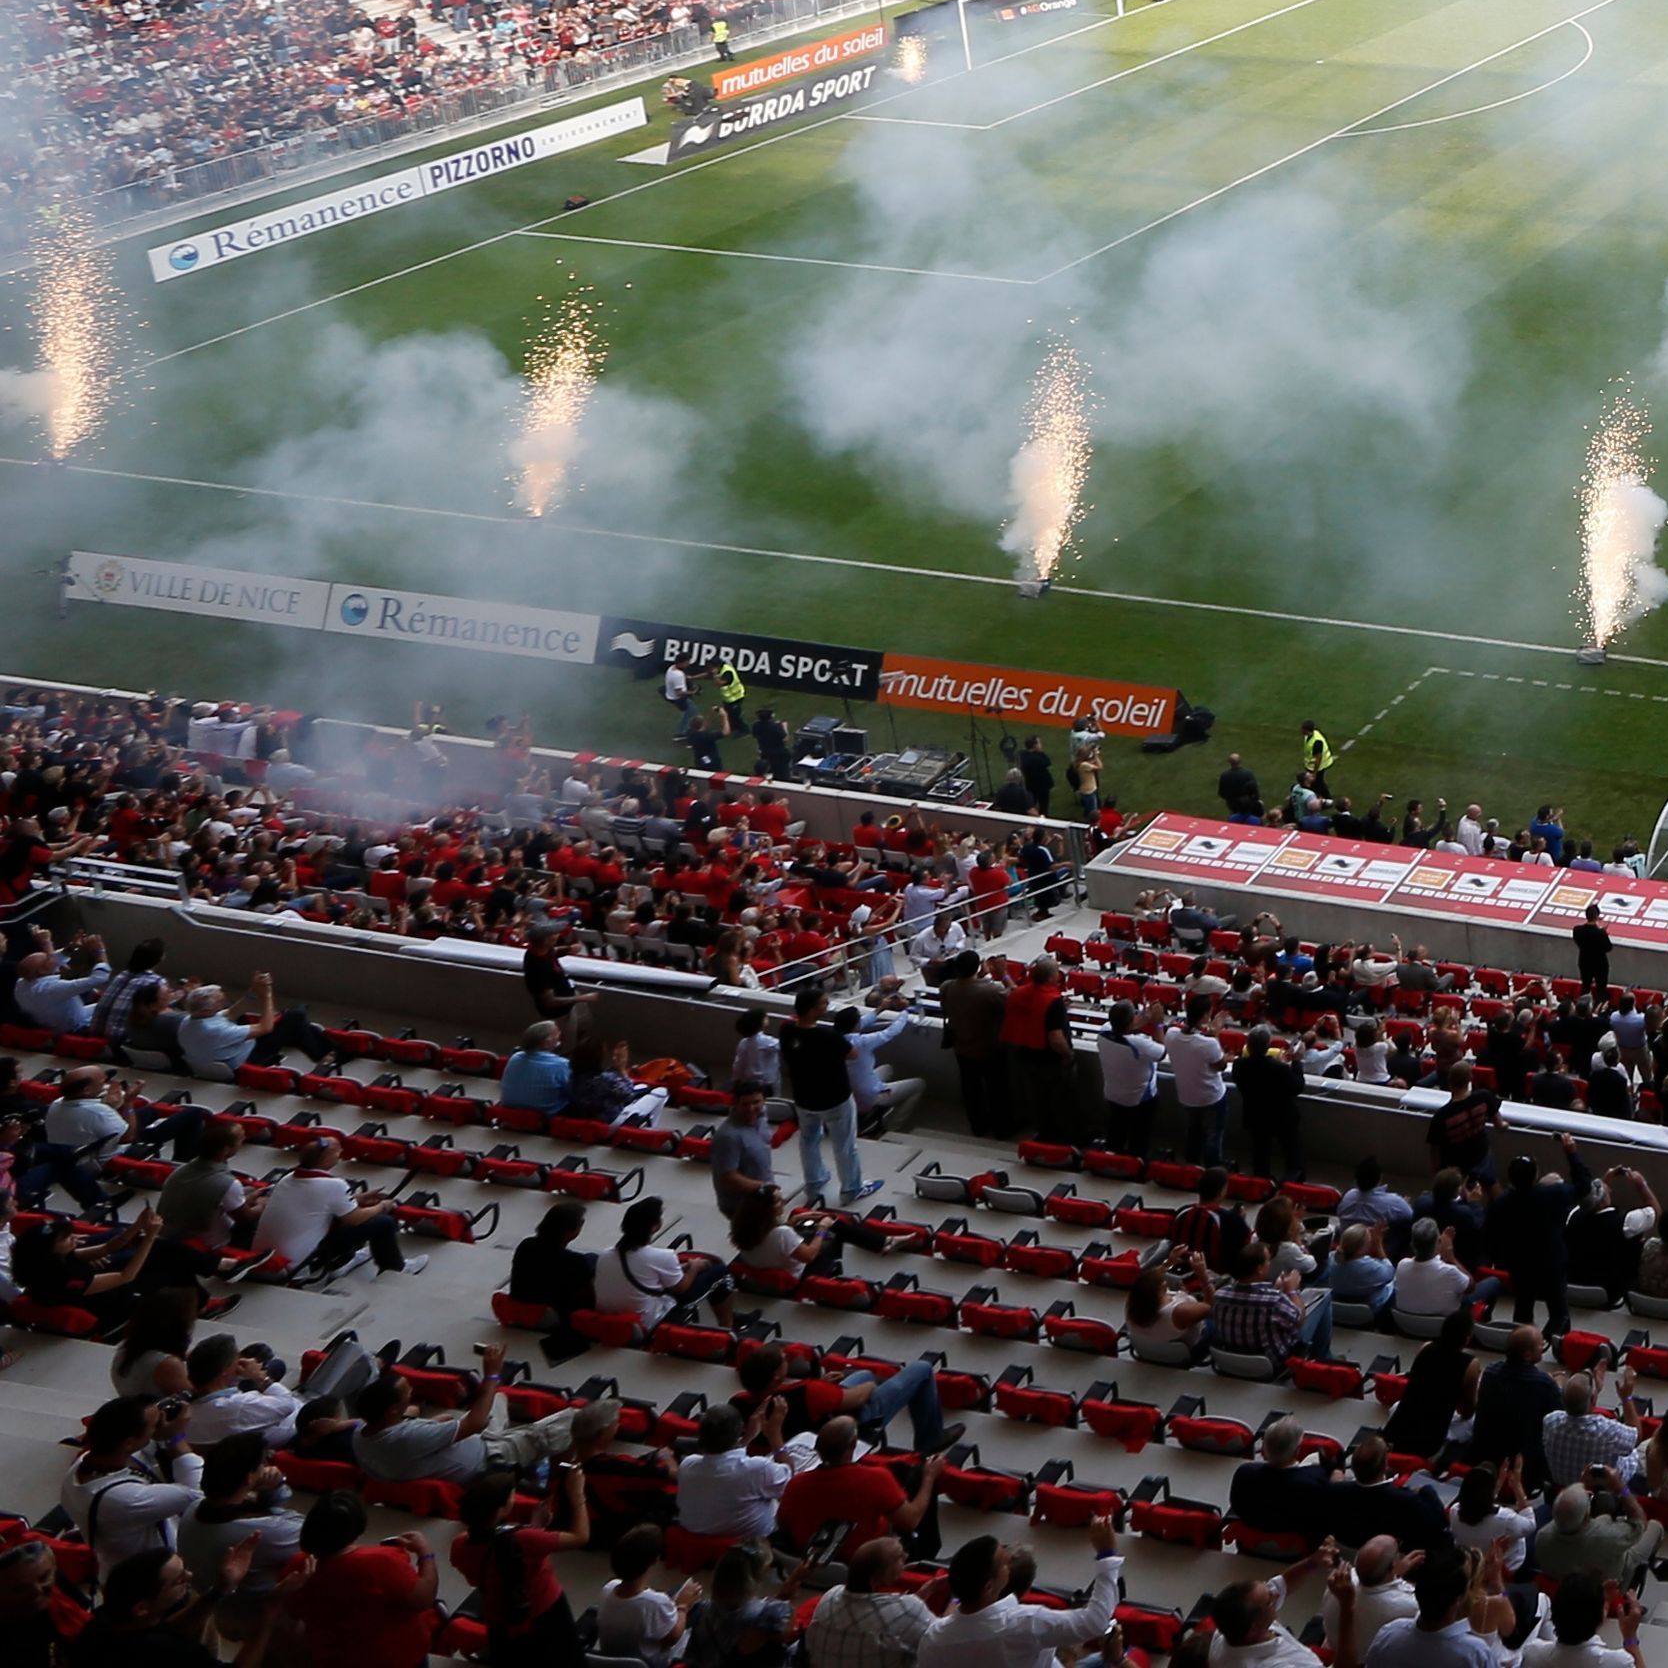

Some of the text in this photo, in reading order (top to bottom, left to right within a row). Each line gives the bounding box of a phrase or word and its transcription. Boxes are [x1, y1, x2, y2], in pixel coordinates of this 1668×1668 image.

[721, 26, 884, 95] mutuelles du soleil
[808, 65, 877, 108] SPORT
[430, 136, 536, 189] PIZZORNO
[211, 182, 414, 260] Rémanence
[129, 569, 302, 615] VILLE DE NICE
[375, 596, 582, 654] Rémanence
[885, 667, 1167, 730] mutuelles du soleil
